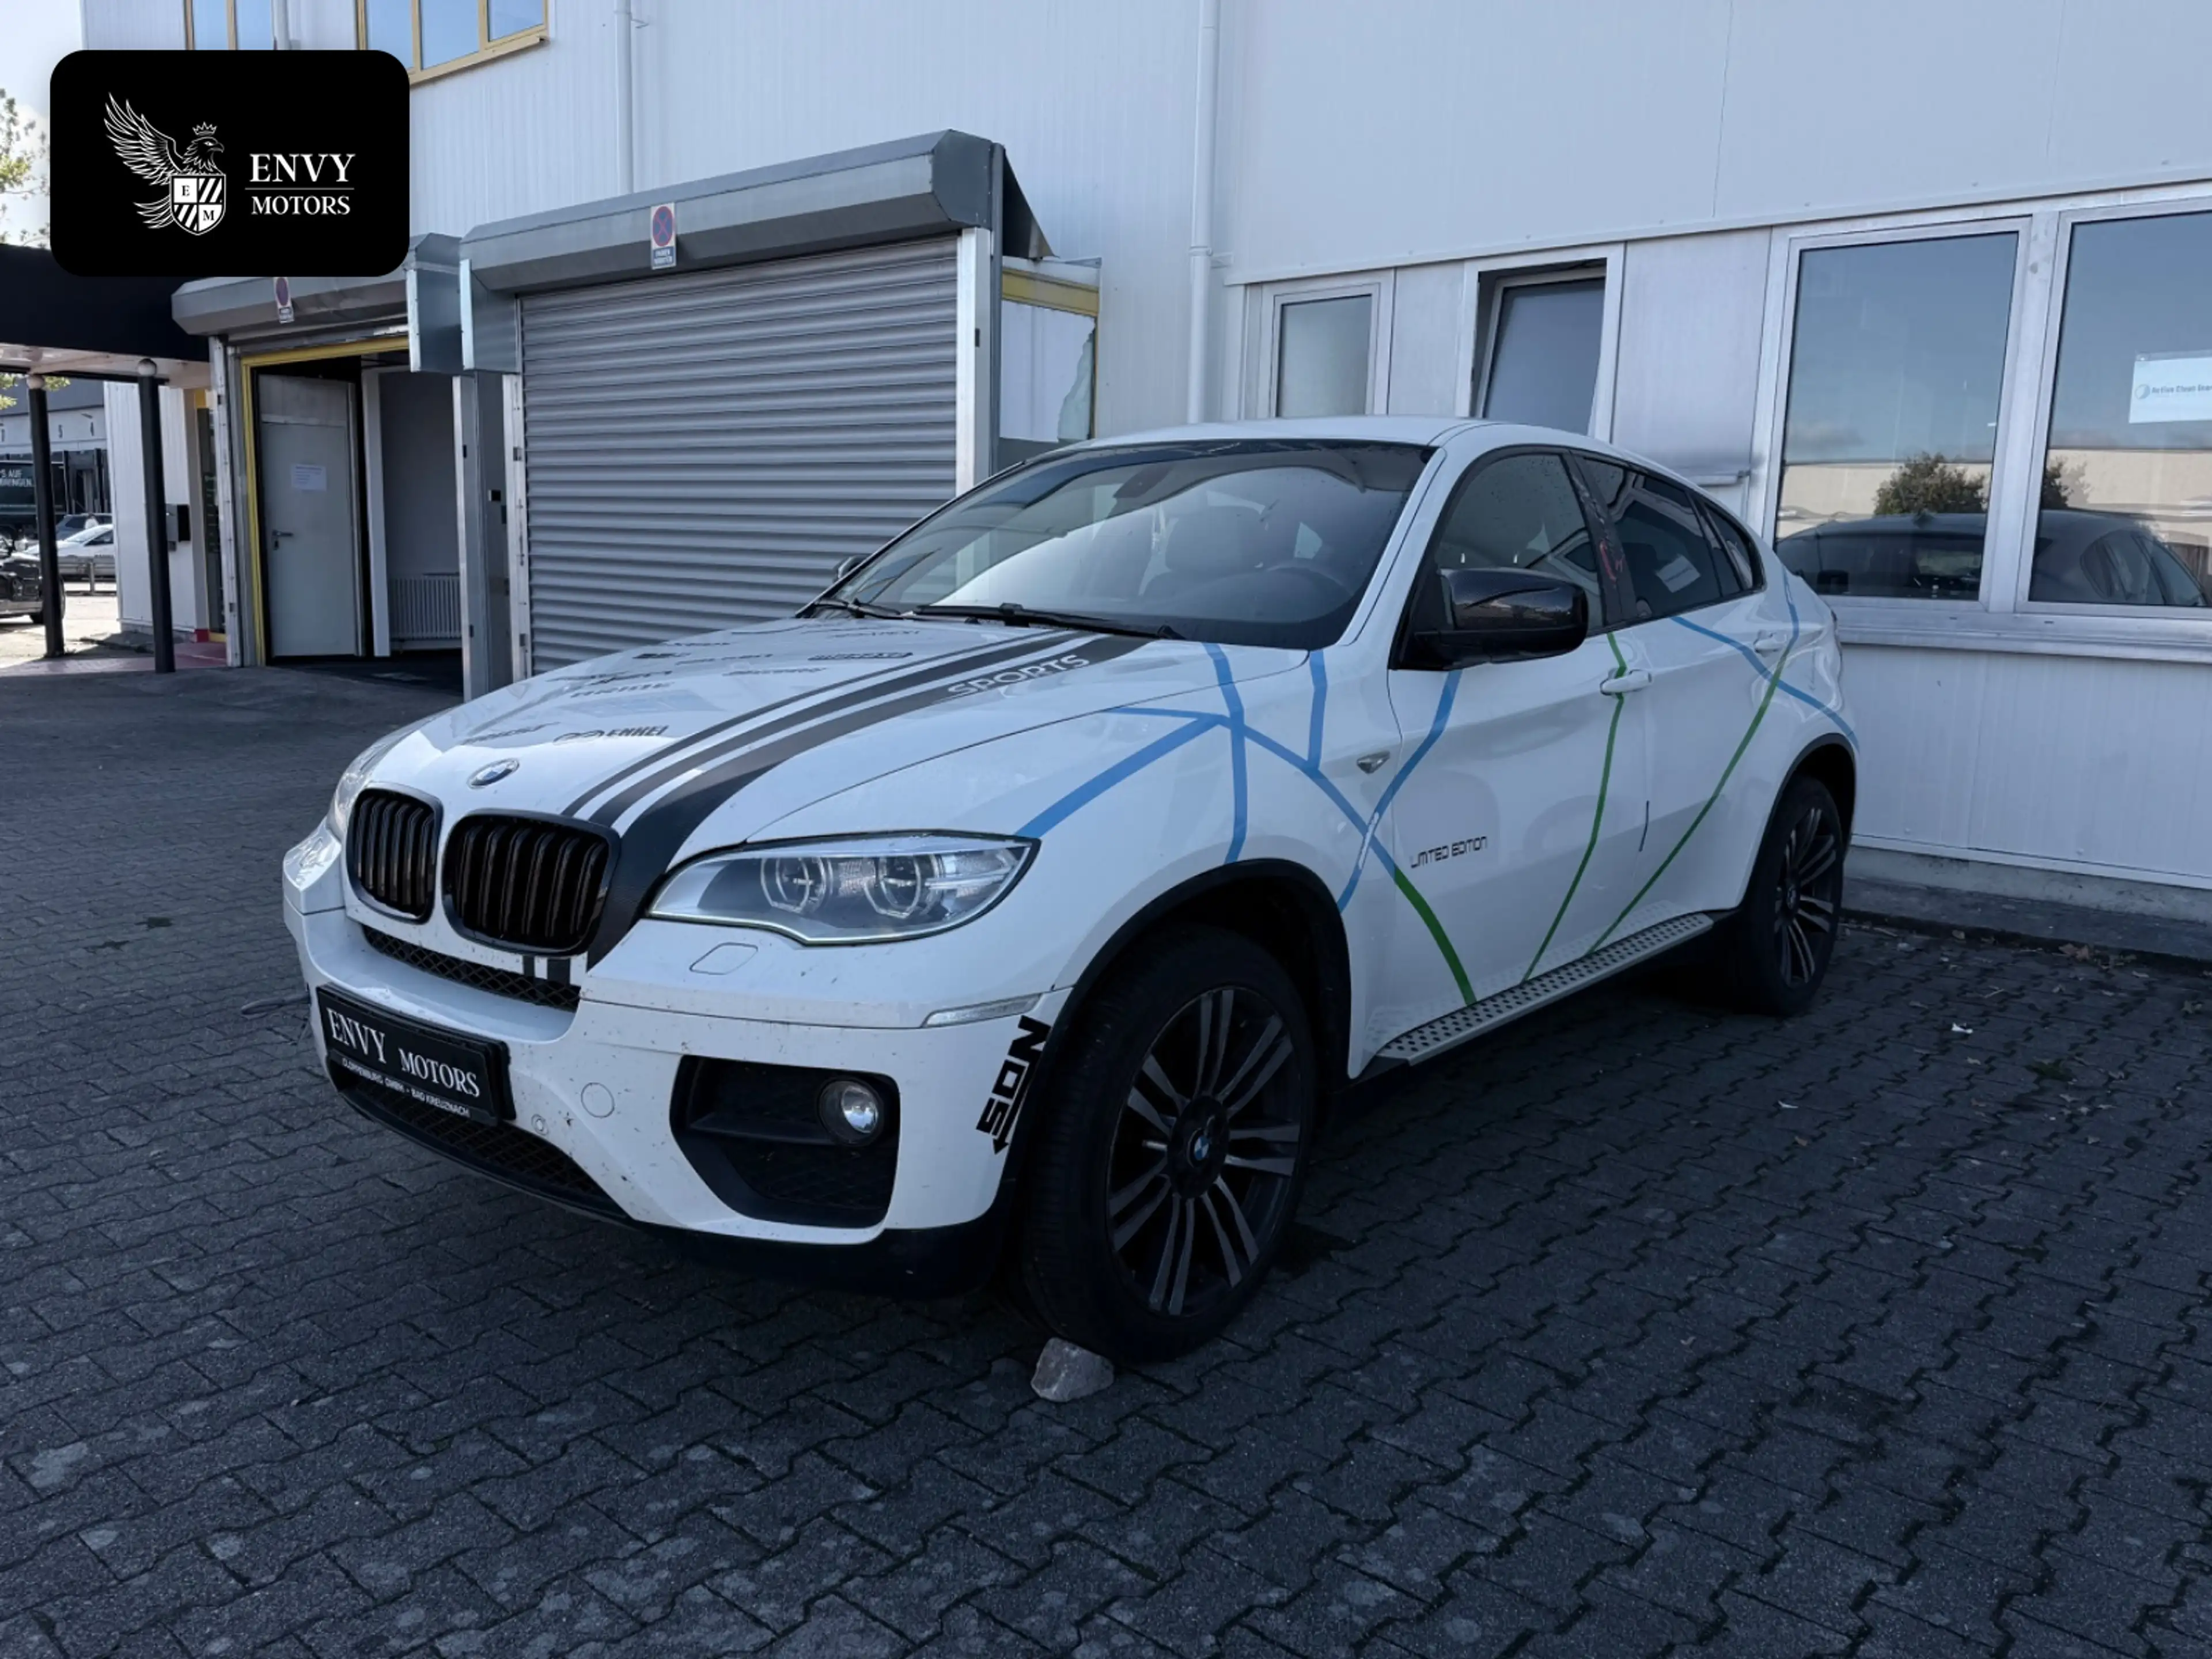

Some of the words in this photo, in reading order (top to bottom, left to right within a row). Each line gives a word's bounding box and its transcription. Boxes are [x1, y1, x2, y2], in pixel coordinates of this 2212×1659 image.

[2152, 385, 2174, 393] Active
[947, 654, 1090, 694] SPORTS
[327, 1006, 387, 1065] ENVY
[398, 1047, 480, 1098] MOTORS
